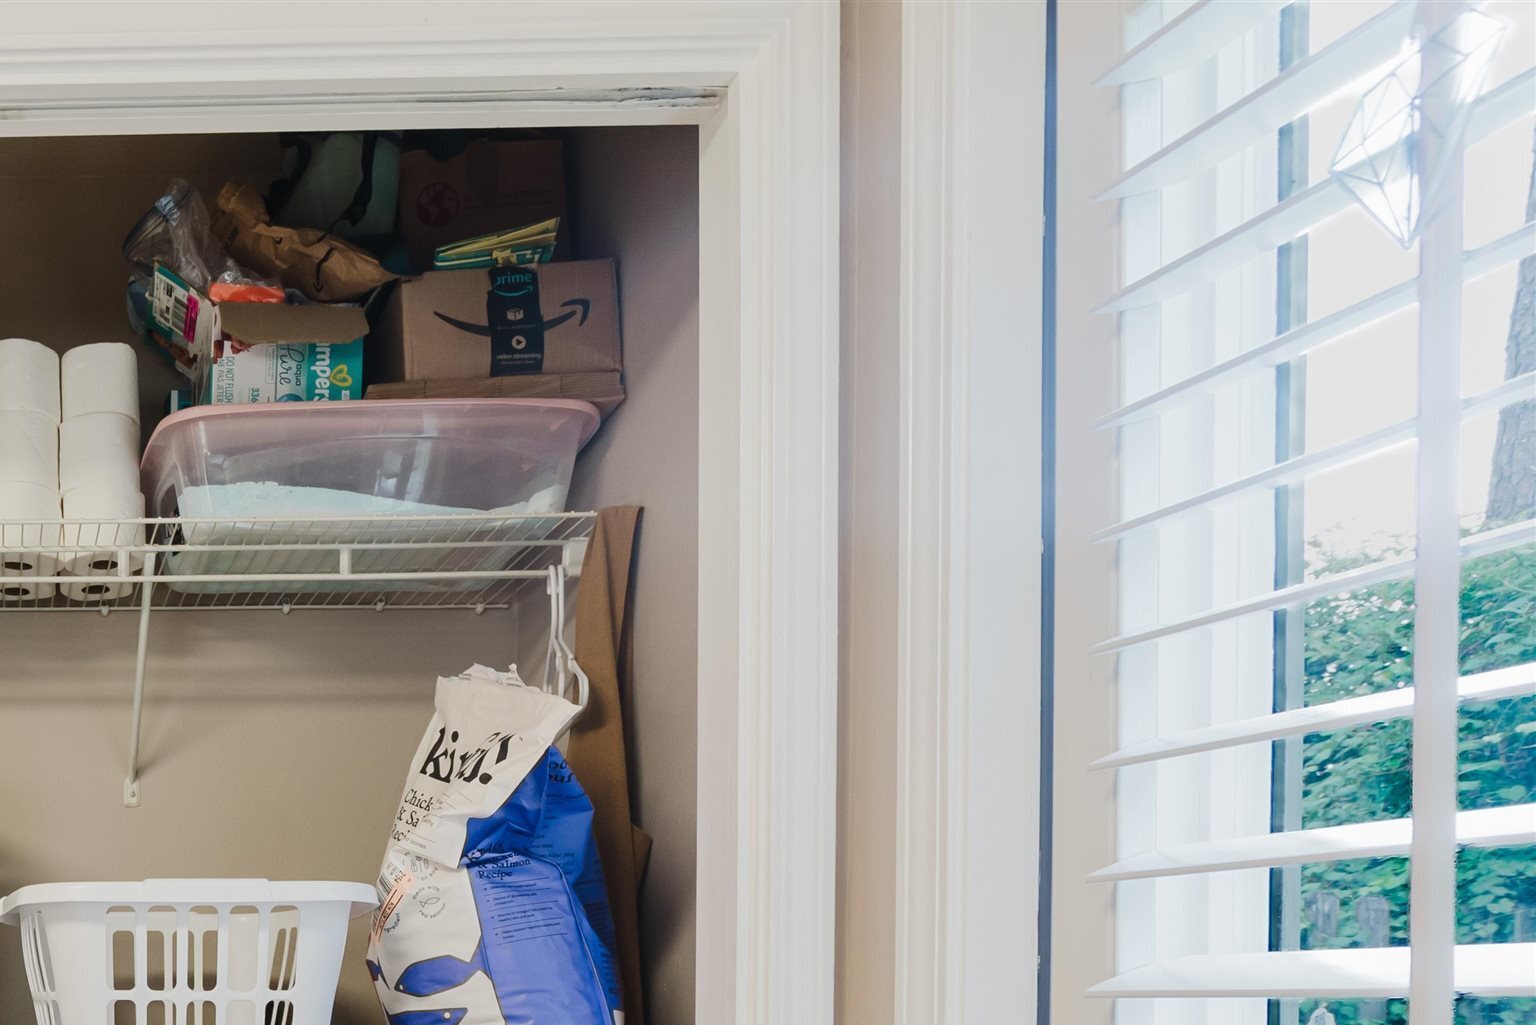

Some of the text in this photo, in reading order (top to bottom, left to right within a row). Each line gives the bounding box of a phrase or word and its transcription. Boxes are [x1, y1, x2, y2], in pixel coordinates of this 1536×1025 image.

[226, 356, 235, 367] DO
[226, 368, 234, 384] NOT
[492, 858, 532, 869] Salmon
[478, 870, 513, 880] Recipe
